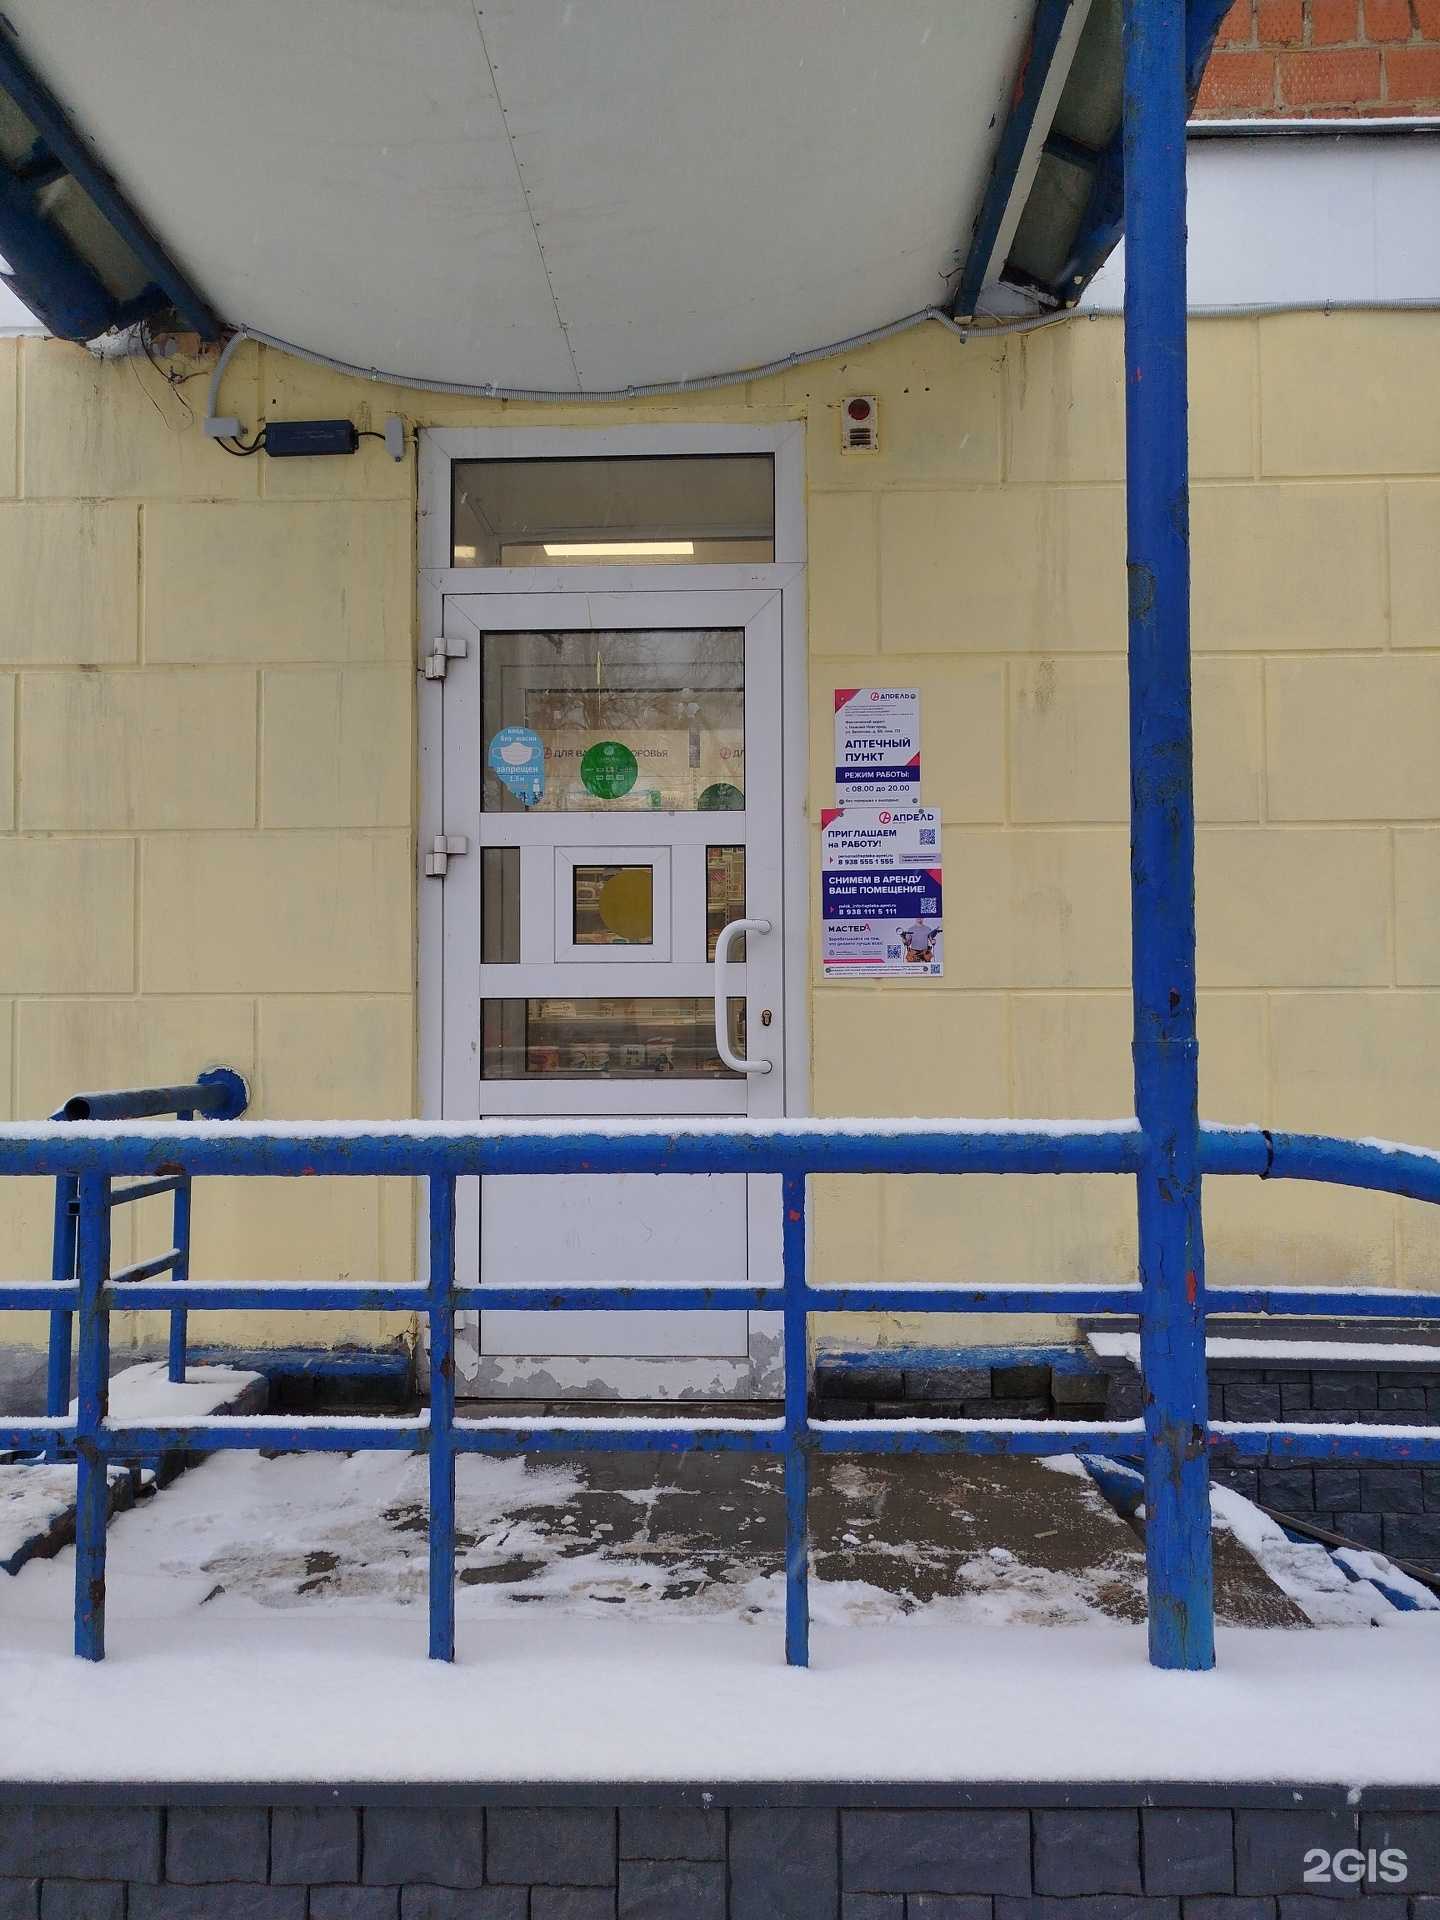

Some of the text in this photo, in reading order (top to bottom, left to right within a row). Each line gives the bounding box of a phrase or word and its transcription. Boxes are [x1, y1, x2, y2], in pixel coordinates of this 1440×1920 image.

[845, 737, 911, 749] АПТЕЧНЫЙ
[845, 752, 884, 762] ПУНКТ
[845, 771, 874, 779] РЕЖИМ
[892, 813, 934, 822] АПРЕЛЬ
[828, 829, 897, 838] ПРИГЛАШАЕМ
[841, 840, 882, 848] РАБОТУ!
[829, 875, 921, 885] СНИМЕМ В АРЕНДУ
[829, 885, 926, 895] ВАШЕ ПОМЕЩЕНИЕ!
